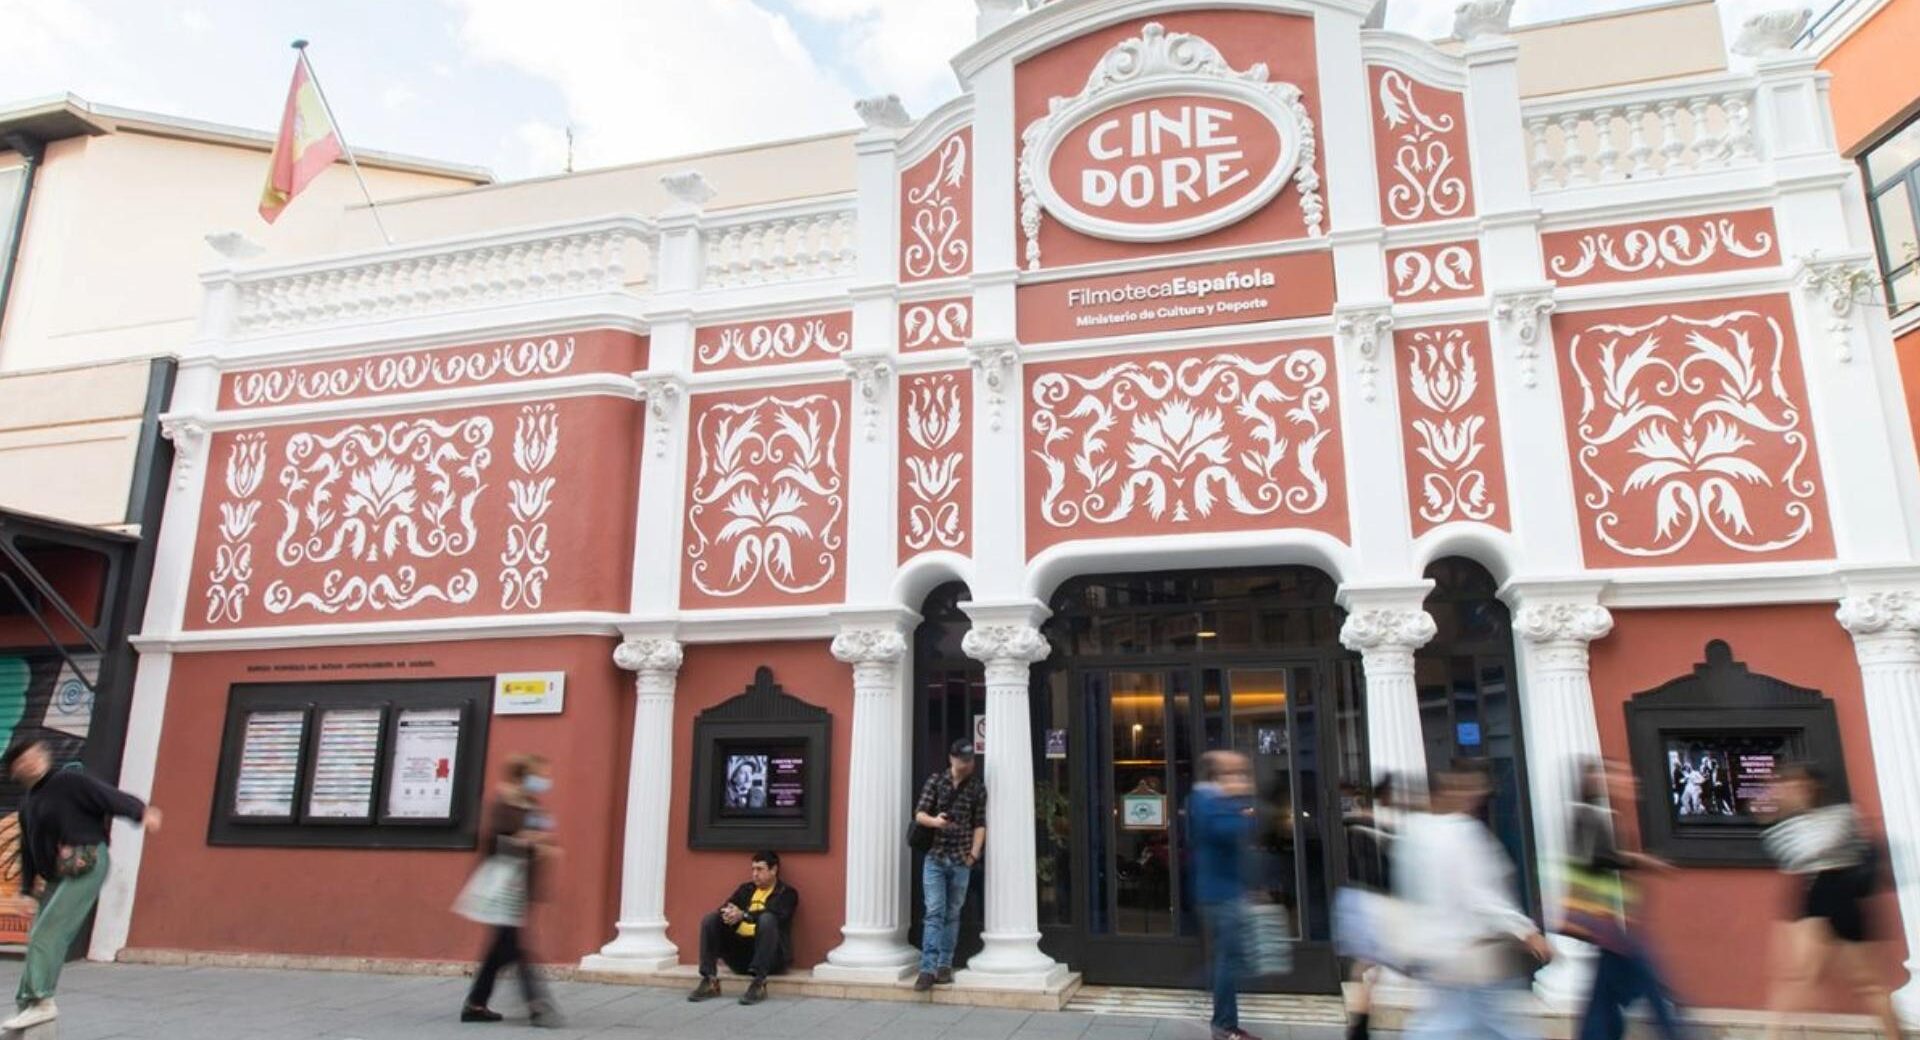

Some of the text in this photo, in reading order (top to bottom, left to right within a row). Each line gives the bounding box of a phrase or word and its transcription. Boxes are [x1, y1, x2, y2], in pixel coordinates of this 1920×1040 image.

[1088, 106, 1236, 160] CINE
[1082, 150, 1249, 208] DORE
[1067, 268, 1274, 307] FilmotecaEspañola
[1076, 298, 1268, 327] Ministerio de Cultura y Deporte
